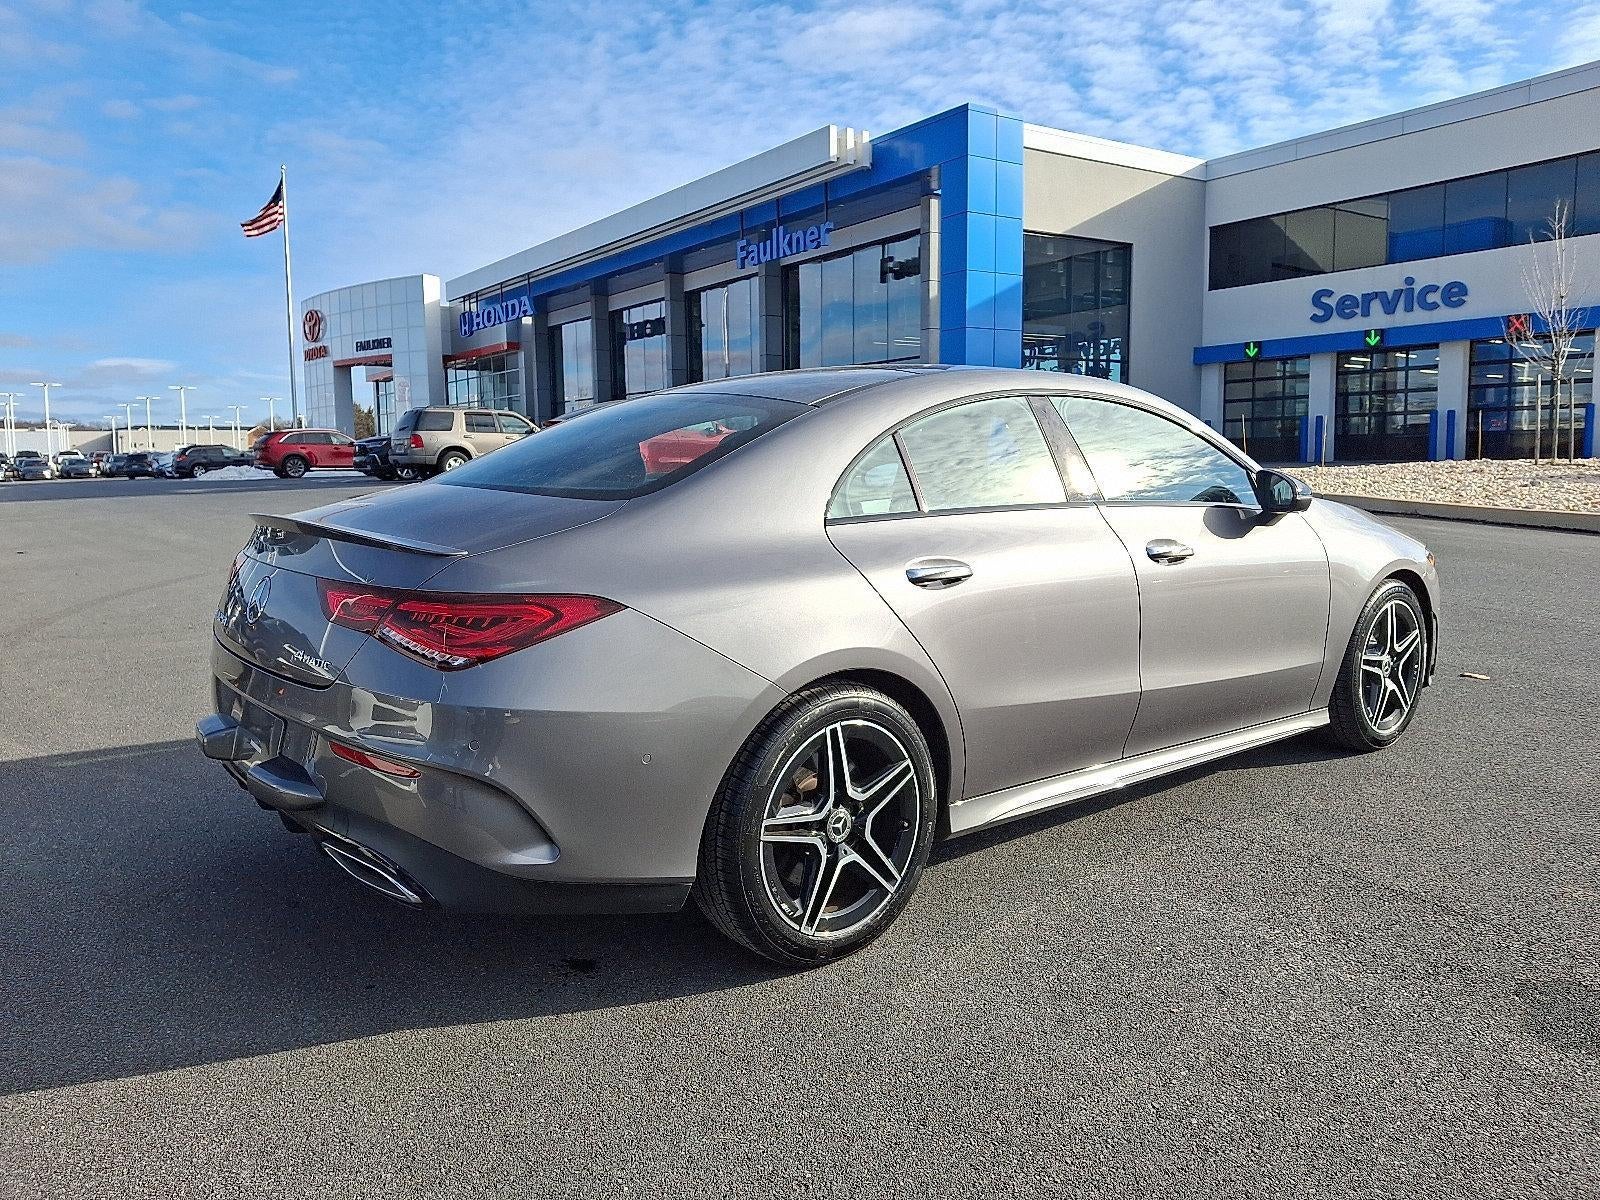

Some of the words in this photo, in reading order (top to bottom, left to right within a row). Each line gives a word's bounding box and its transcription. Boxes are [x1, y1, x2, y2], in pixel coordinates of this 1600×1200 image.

[736, 221, 834, 269] Faulkner
[472, 296, 534, 331] HONDA
[1309, 276, 1468, 323] Service
[356, 337, 392, 352] FAULKNER
